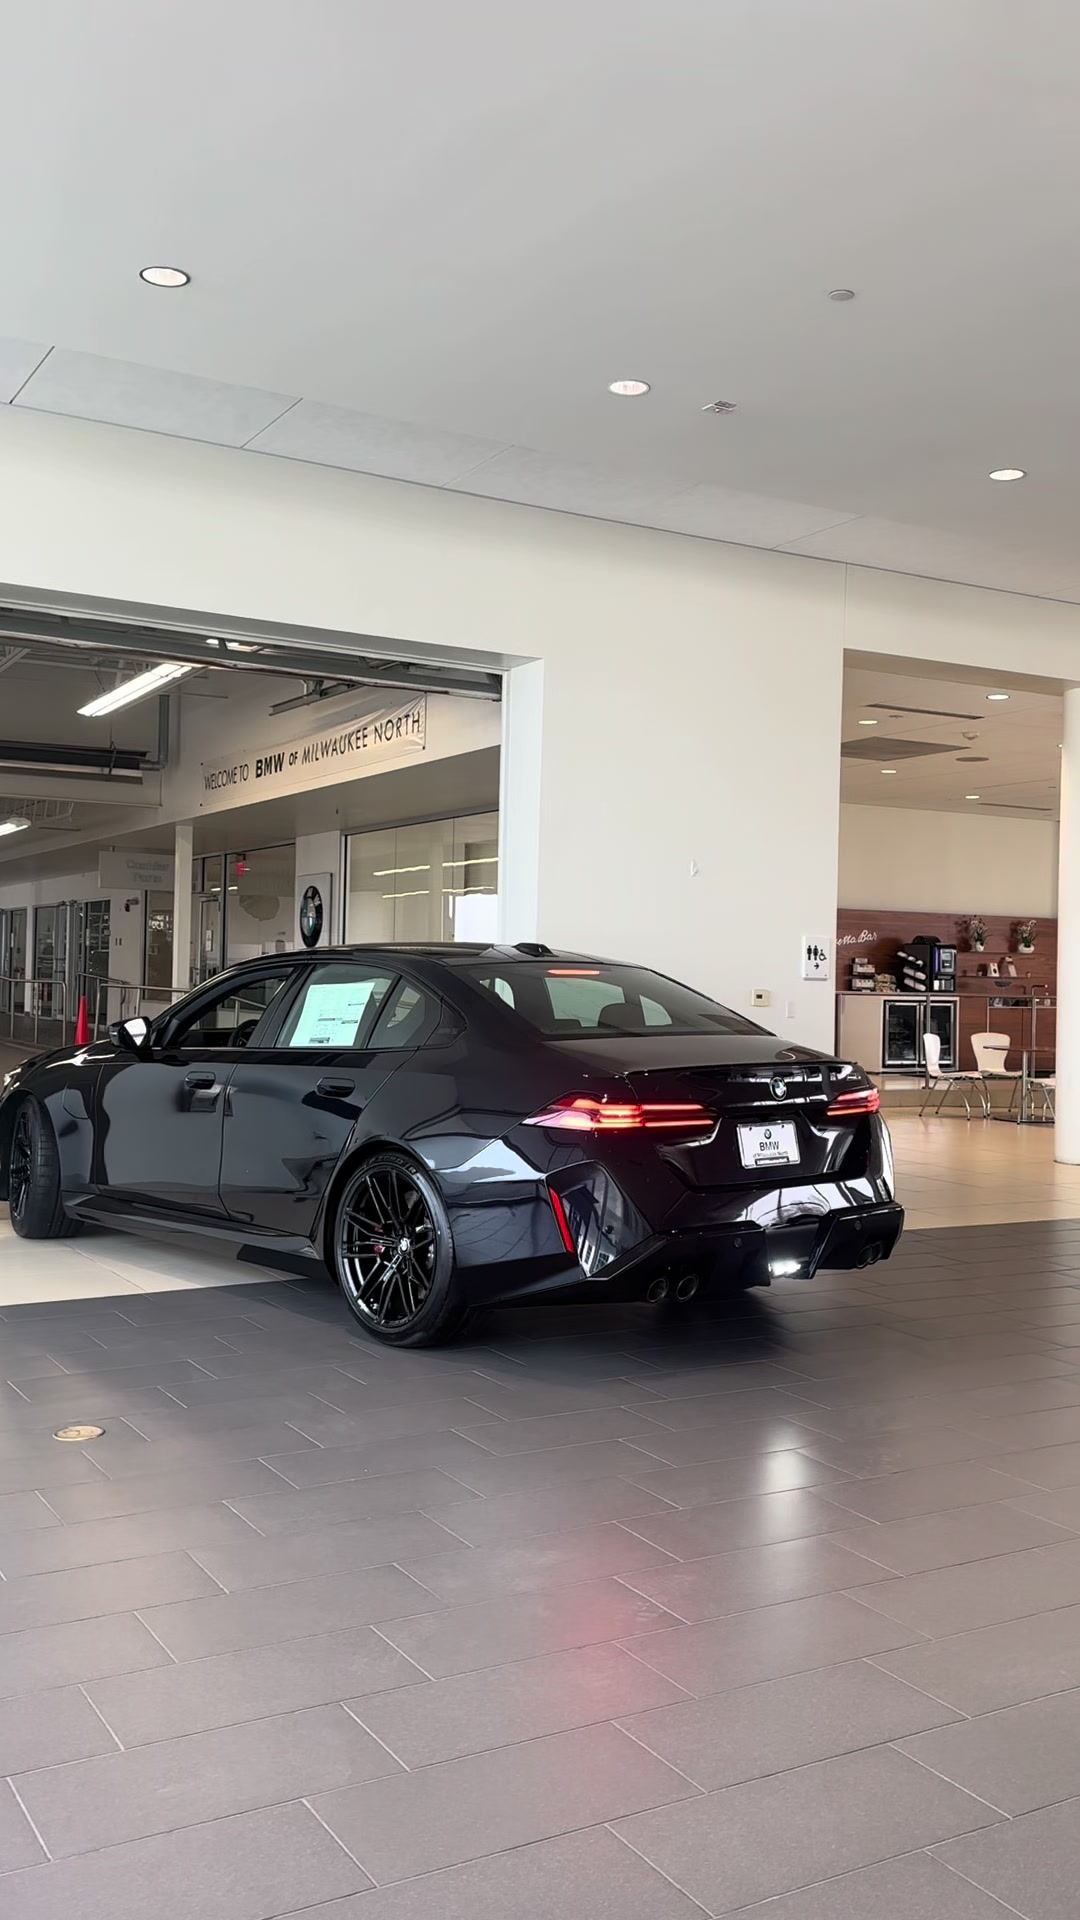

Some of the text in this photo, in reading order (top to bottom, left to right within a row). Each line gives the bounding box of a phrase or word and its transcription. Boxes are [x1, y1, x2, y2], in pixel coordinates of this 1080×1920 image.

[204, 711, 421, 791] WELCOME TO BMW OF MILWAUKEE NORTH
[858, 929, 877, 943] Bar
[759, 1141, 779, 1151] BMW
